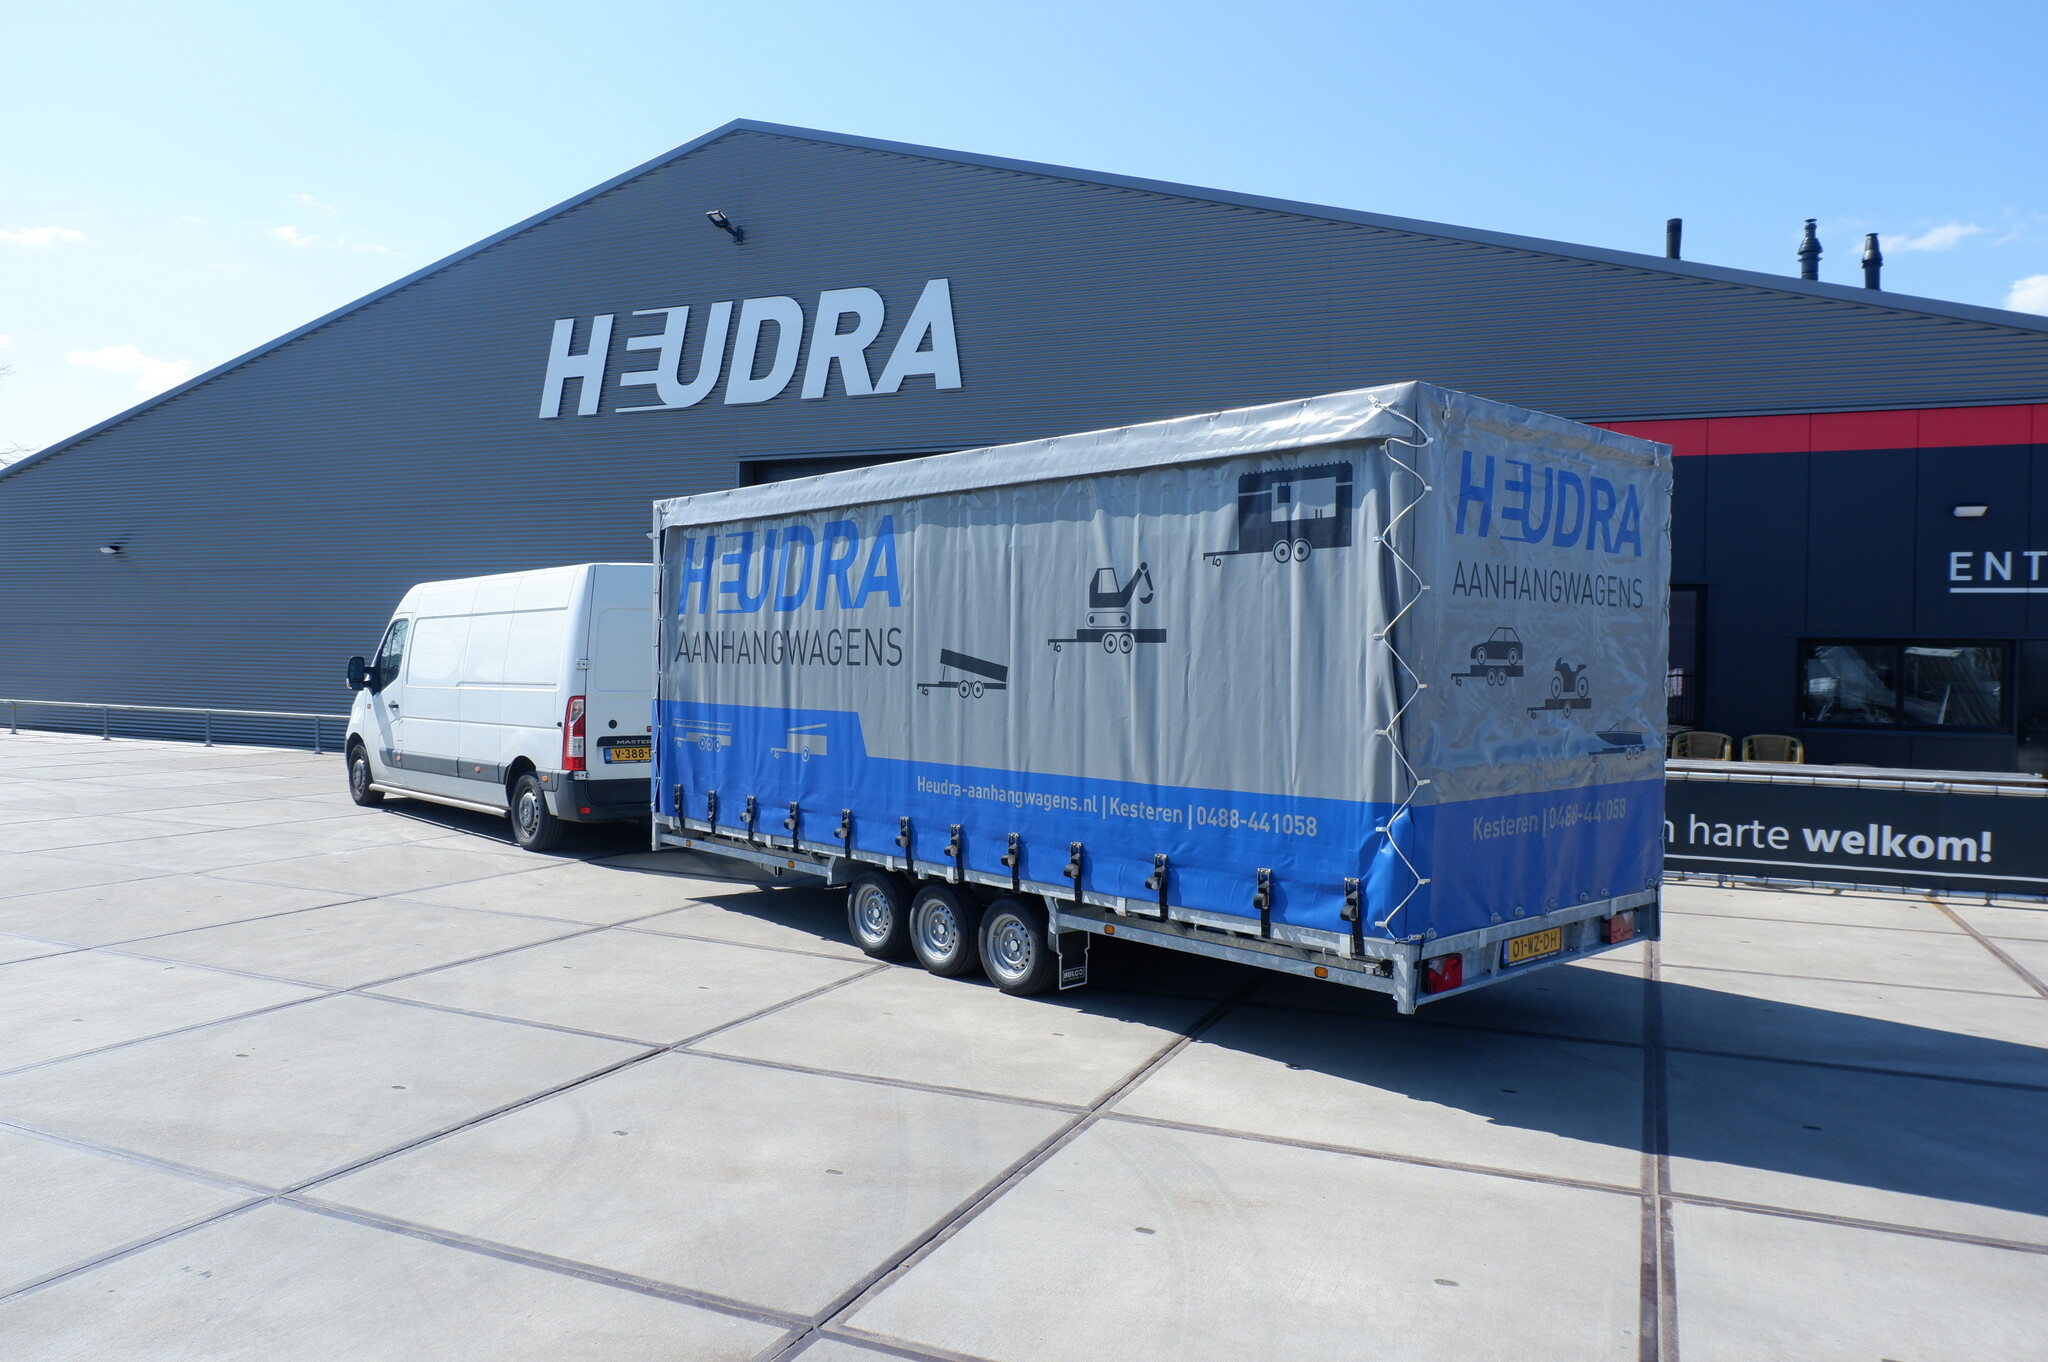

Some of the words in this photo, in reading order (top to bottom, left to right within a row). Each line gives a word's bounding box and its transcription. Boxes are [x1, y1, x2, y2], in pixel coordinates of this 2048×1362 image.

[539, 278, 962, 418] HEUDRA
[1455, 450, 1642, 557] HEUDRA
[678, 515, 901, 615] HEUDRA
[1453, 560, 1643, 609] AANHANGWAGENS
[674, 627, 903, 667] AANHANGWAGENS
[917, 776, 1098, 813] Heudra-aanhangwagens.nl
[1110, 797, 1183, 824] Kesteren
[1196, 806, 1318, 837] 0488-441058
[1473, 814, 1539, 841] Kesteren
[1549, 797, 1627, 829] 0488-44058
[1689, 814, 1790, 850] harte
[1802, 824, 1993, 864] welkom!
[1512, 931, 1557, 958] 01-WZ-DH
